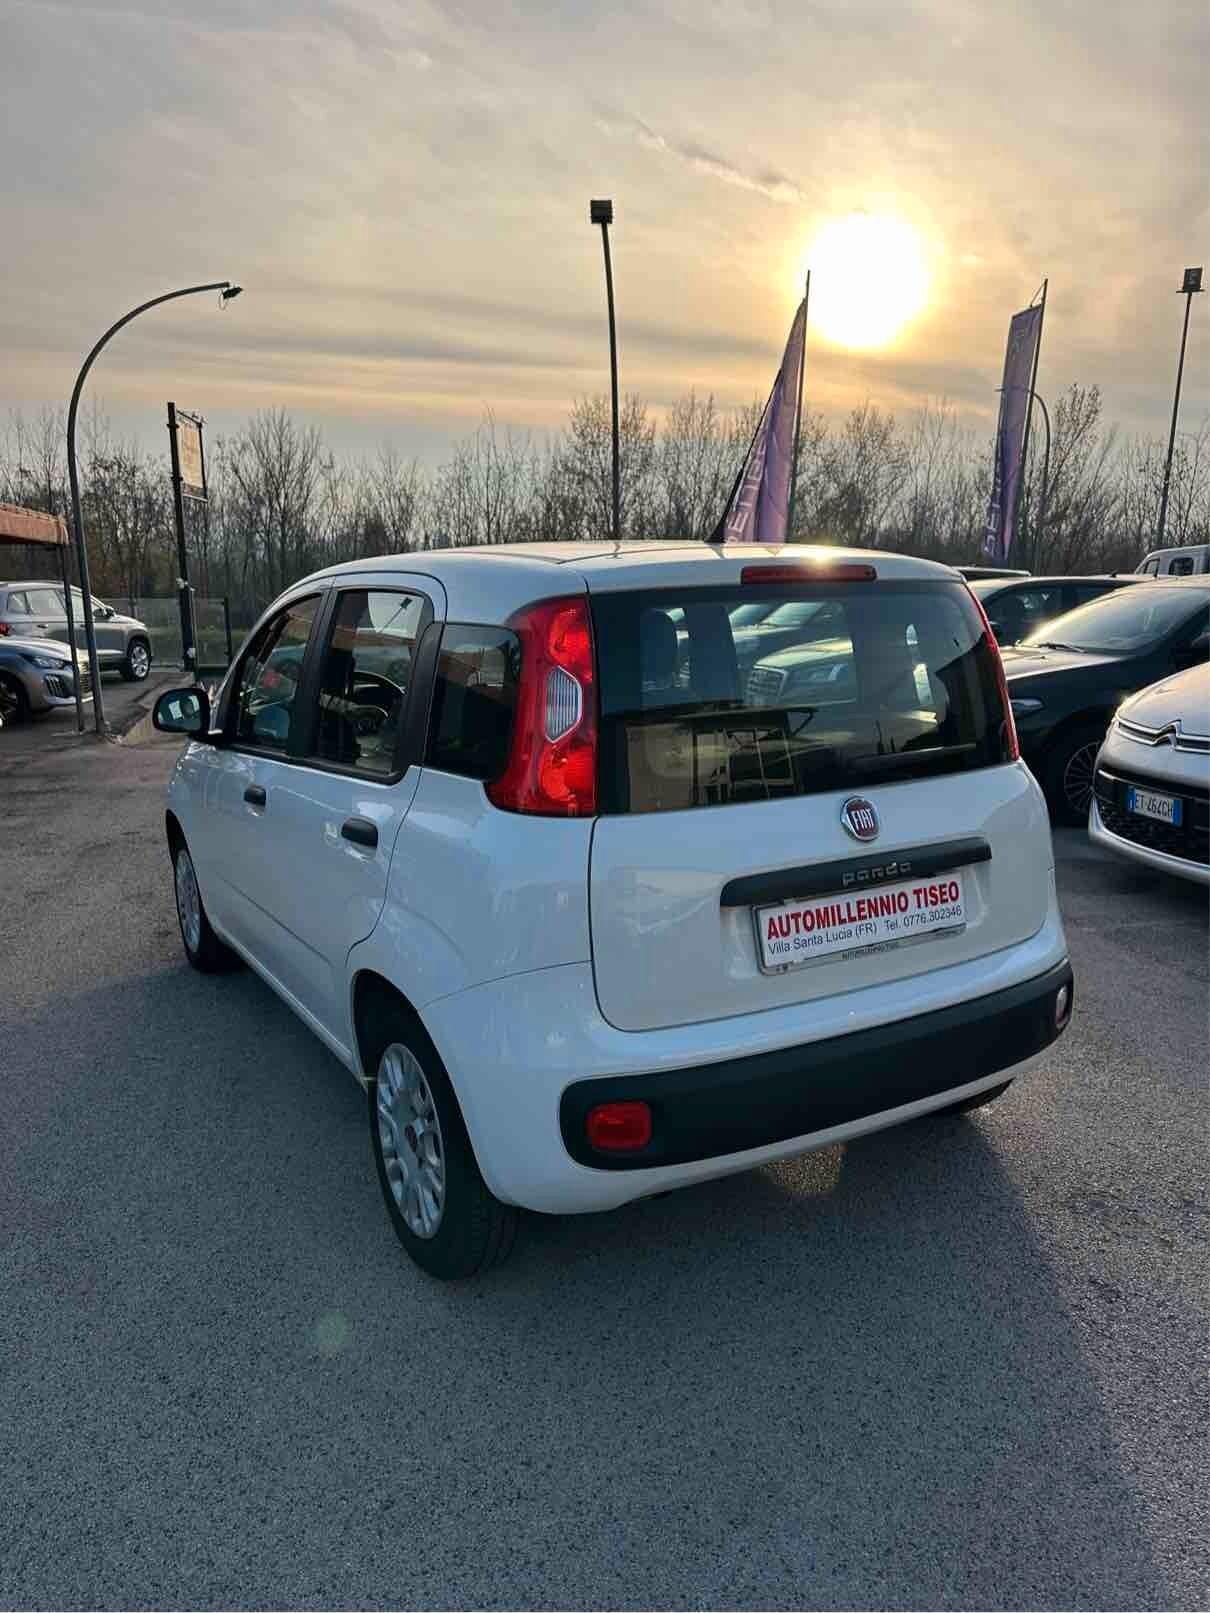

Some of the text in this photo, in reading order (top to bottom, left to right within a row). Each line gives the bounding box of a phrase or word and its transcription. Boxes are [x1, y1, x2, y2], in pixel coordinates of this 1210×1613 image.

[851, 808, 875, 831] FIAT
[768, 881, 960, 940] AUTOMILLENNIO TISEO
[768, 940, 791, 955] Villa
[793, 934, 823, 950] Santa
[826, 927, 853, 943] Lucia
[855, 921, 878, 938] (FR)
[885, 917, 902, 931] Tel.
[903, 904, 962, 928] 0776.302346
